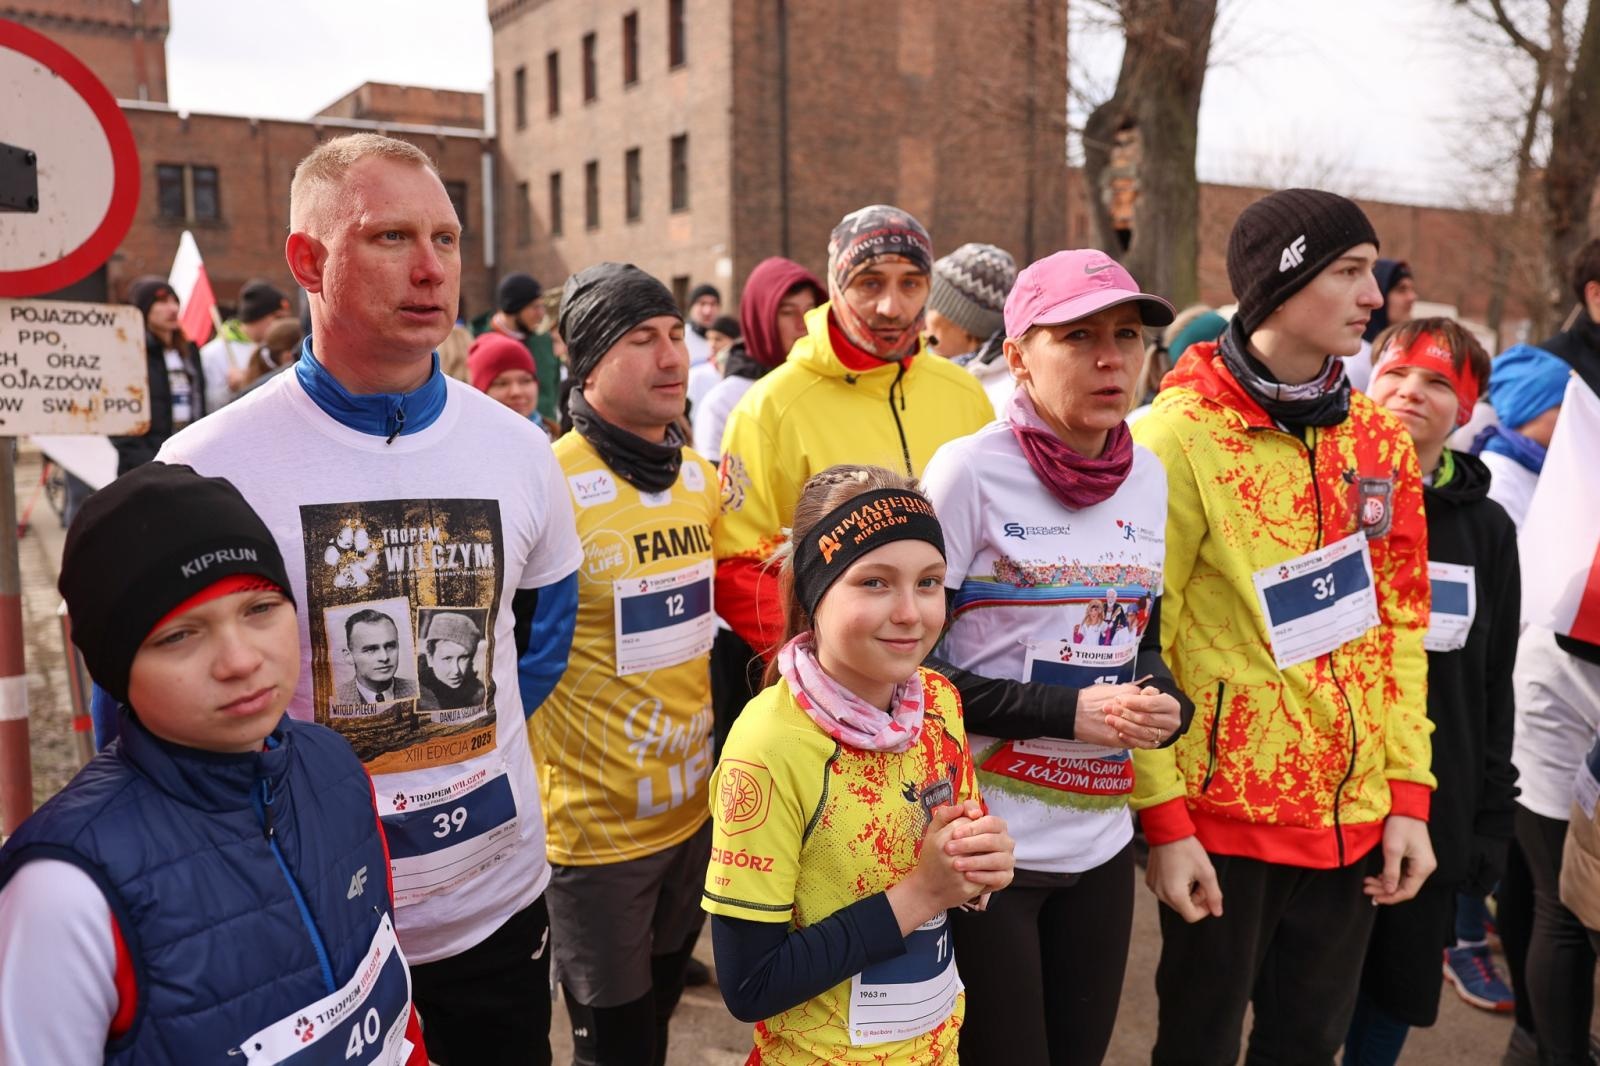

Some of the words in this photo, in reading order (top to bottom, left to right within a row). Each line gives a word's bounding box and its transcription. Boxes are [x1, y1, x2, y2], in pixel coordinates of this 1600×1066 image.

[1279, 234, 1306, 272] 4F
[10, 306, 116, 326] POJAZDÓW
[47, 353, 100, 369] ORAZ
[0, 372, 102, 391] OJAZDÓW
[103, 399, 142, 413] PPO
[854, 515, 907, 544] MIKOŁÓW
[857, 508, 893, 530] KIDS
[381, 527, 440, 546] TROPEM
[633, 524, 711, 564] FAMIL
[181, 548, 258, 578] KIPRUN
[384, 543, 494, 573] WILCZYM
[589, 553, 624, 574] LIFE
[665, 594, 684, 616] 12
[1075, 651, 1113, 660] TROPEM
[332, 704, 354, 716] WITOLD
[355, 703, 377, 715] PILECKI
[440, 709, 461, 722] DANUTA
[406, 747, 423, 763] XIII
[426, 741, 469, 760] EDYCJA
[471, 731, 492, 750] 2025
[1008, 760, 1026, 773] Z
[1025, 764, 1089, 788] KAŻDYM
[1092, 777, 1132, 790] KROKIEM
[1047, 756, 1125, 775] POMAGAMY
[409, 787, 452, 803] TROPEM
[452, 769, 487, 791] WILCZYM
[636, 744, 712, 820] LIF
[433, 806, 467, 838] 39
[711, 848, 774, 872] CIBÓRZ
[347, 865, 368, 900] 4F
[715, 876, 731, 887] 1217
[936, 929, 948, 963] 11
[316, 985, 361, 1023] TROPEM
[345, 1007, 381, 1060] 40
